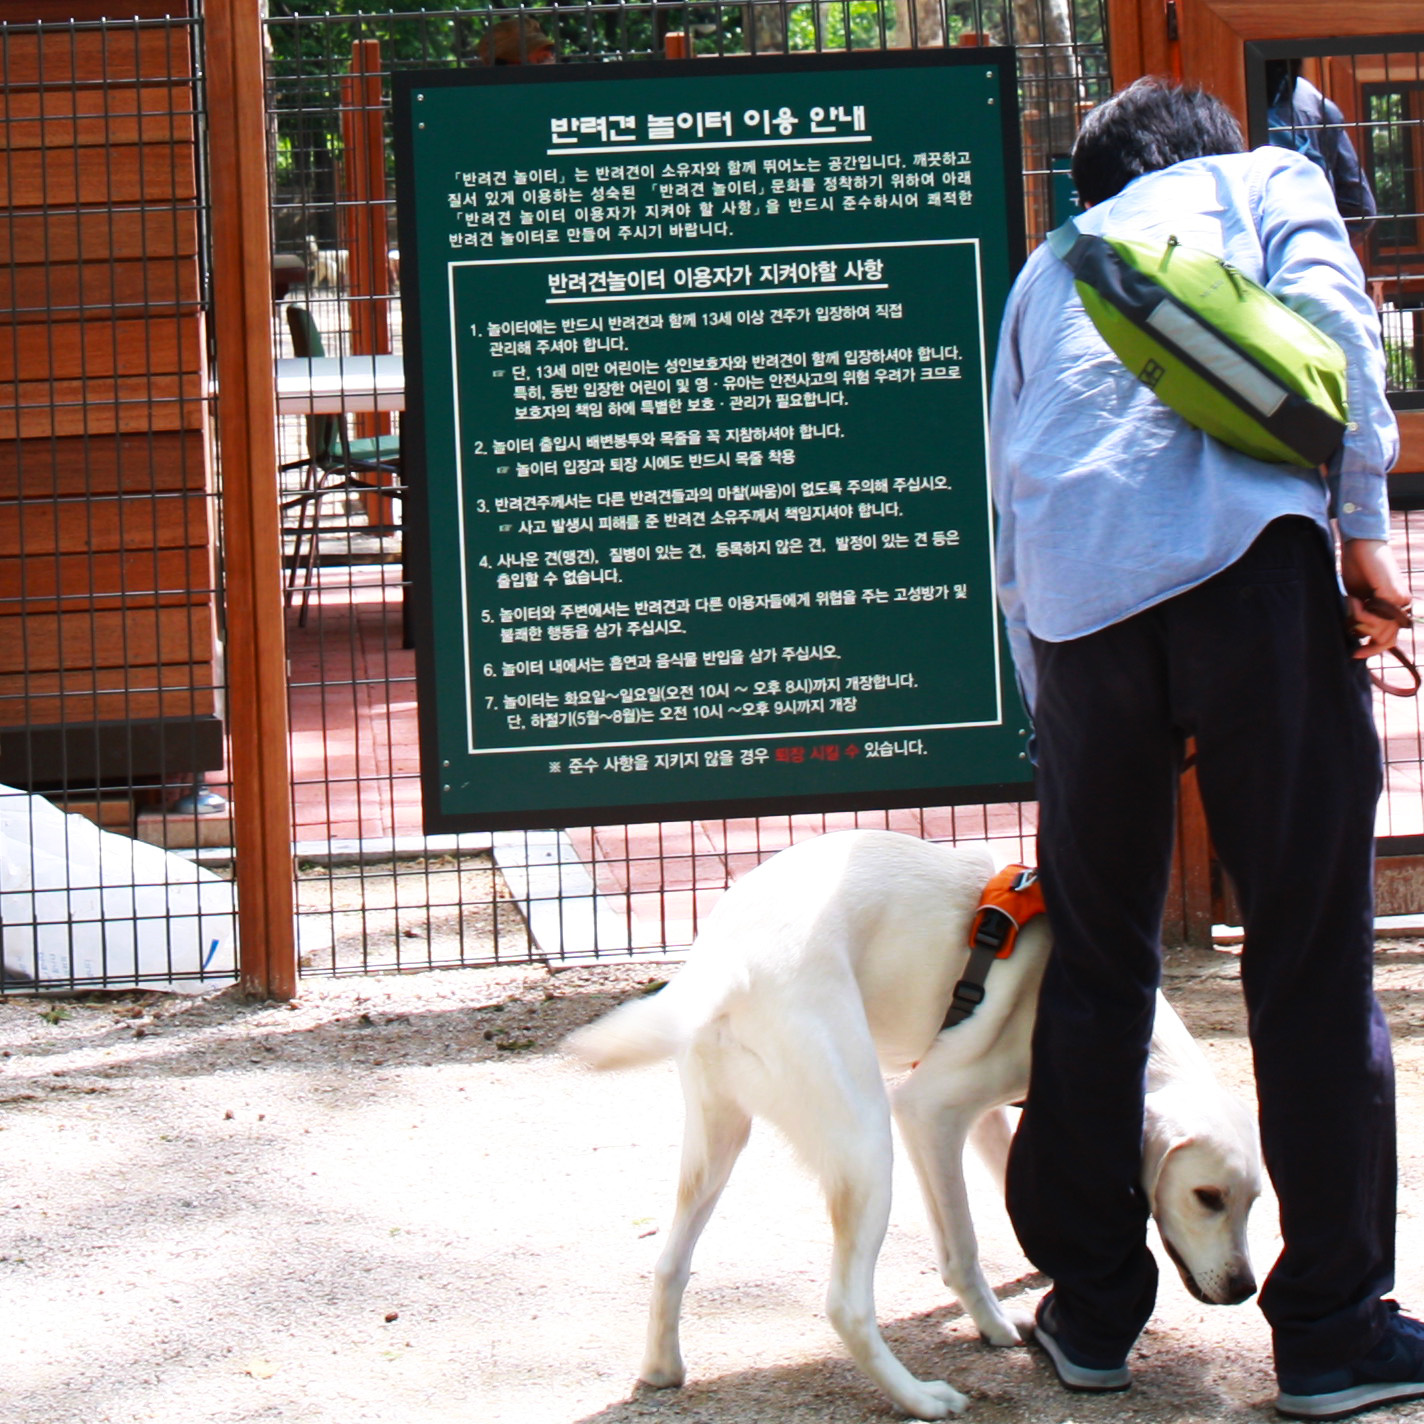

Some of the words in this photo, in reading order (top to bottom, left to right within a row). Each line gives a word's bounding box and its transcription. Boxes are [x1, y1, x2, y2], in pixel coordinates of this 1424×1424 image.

[550, 115, 637, 144] 반려견
[647, 111, 733, 140] 놀이터
[743, 107, 799, 136] 이용
[809, 105, 866, 134] 안내
[595, 163, 655, 182] 반려견이
[661, 161, 721, 178] 소유자와
[727, 159, 757, 176] 함께
[763, 157, 822, 174] 뛰어노는
[828, 153, 906, 172] 공간입니다.
[913, 151, 971, 167] 깨끗하고
[447, 191, 477, 209] 질서
[484, 190, 515, 207] 있게
[522, 187, 584, 205] 이용하는
[591, 185, 636, 202] 성숙된
[823, 174, 883, 192] 정착하기
[891, 172, 935, 189] 위하여
[942, 170, 972, 186] 아래
[519, 208, 566, 225] 놀이터
[574, 205, 637, 223] 이용자가
[645, 202, 691, 219] 지켜야
[788, 196, 834, 213] 반드시
[842, 193, 918, 211] 준수하시어
[927, 190, 973, 207] 쾌적한
[449, 231, 494, 249] 반려견
[500, 228, 560, 246] 놀이터로
[566, 226, 611, 243] 만들어
[618, 224, 662, 241] 주시기
[669, 221, 733, 238] 바랍니다.
[548, 268, 666, 295] 반려견놀이터
[674, 264, 753, 289] 이용자가
[759, 260, 838, 285] 지켜야할
[844, 258, 884, 281] 사항
[486, 319, 557, 338] 놀이터에는
[561, 316, 603, 334] 반드시
[608, 314, 664, 332] 반려견과
[668, 312, 697, 329] 함께
[702, 311, 732, 326] 13세
[736, 309, 765, 326] 이상
[770, 307, 811, 324] 견주가
[815, 304, 870, 322] 입장하여
[875, 303, 903, 319] 직접
[489, 340, 532, 357] 관리해
[536, 337, 579, 355] 주셔야
[582, 336, 629, 353] 합니다.
[536, 363, 567, 379] 13세
[571, 362, 600, 378] 미만
[604, 359, 660, 377] 어린이는
[664, 355, 748, 374] 성인보호자와
[751, 352, 807, 370] 반려견이
[811, 350, 840, 367] 함께
[844, 347, 913, 366] 입장하셔야
[917, 345, 963, 362] 합니다.
[513, 385, 546, 401] 특히,
[550, 383, 579, 400] 동반
[583, 381, 626, 398] 입장한
[629, 378, 671, 395] 어린이
[722, 375, 765, 391] 유아는
[769, 370, 838, 389] 안전사고의
[842, 369, 870, 385] 위험
[874, 367, 916, 384] 우려가
[920, 365, 962, 381] 크므로
[514, 404, 571, 420] 보호자의
[575, 402, 603, 418] 책임
[608, 400, 636, 417] 하에
[640, 398, 683, 415] 특별한
[686, 397, 716, 412] 보호
[729, 394, 772, 412] 관리가
[775, 390, 849, 409] 필요합니다.
[492, 438, 534, 455] 놀이터
[539, 435, 581, 453] 출입시
[586, 431, 656, 450] 배변봉투와
[659, 429, 702, 447] 목줄을
[725, 425, 795, 443] 지참하셔야
[799, 423, 845, 440] 합니다.
[515, 460, 558, 478] 놀이터
[562, 458, 606, 476] 입장과
[609, 456, 638, 473] 퇴장
[642, 455, 685, 471] 시에도
[688, 451, 731, 469] 반드시
[735, 450, 764, 467] 목줄
[768, 448, 796, 465] 착용
[494, 493, 593, 513] 반려견주께서는
[597, 491, 626, 507] 다른
[629, 486, 713, 506] 반려견들과의
[717, 482, 796, 502] 마찰(싸움)이
[800, 480, 843, 498] 없도록
[846, 478, 889, 495] 주의해
[892, 475, 952, 493] 주십시오.
[518, 520, 548, 535] 사고
[551, 516, 594, 534] 발생시
[598, 514, 641, 531] 피해를
[663, 511, 706, 528] 반려견
[710, 507, 780, 525] 소유주께서
[784, 503, 854, 522] 책임지셔야
[857, 501, 903, 519] 합니다.
[496, 551, 540, 569] 사나운
[609, 545, 651, 563] 질병이
[655, 544, 684, 561] 있는
[715, 539, 771, 558] 등록하지
[775, 537, 804, 555] 않은
[835, 534, 877, 552] 발정이
[881, 533, 910, 549] 있는
[496, 571, 540, 590] 출입할
[562, 567, 623, 586] 없습니다.
[499, 605, 556, 623] 놀이터와
[560, 601, 631, 620] 주변에서는
[634, 598, 692, 616] 반려견과
[694, 596, 724, 613] 다른
[727, 591, 811, 611] 이용자들에게
[815, 589, 857, 607] 위협을
[861, 588, 890, 604] 주는
[893, 584, 950, 602] 고성방가
[547, 623, 590, 642] 행동을
[593, 622, 623, 639] 삼가
[626, 619, 687, 637] 주십시오.
[501, 659, 544, 677] 놀이터
[549, 657, 605, 674] 내에서는
[655, 651, 698, 670] 음식물
[702, 648, 745, 667] 반입을
[749, 647, 778, 664] 삼가
[781, 644, 842, 662] 주십시오.
[502, 692, 560, 710] 놀이터는
[699, 682, 730, 699] 10시
[752, 679, 782, 696] 오후
[785, 676, 841, 694] 8시)까지
[845, 672, 918, 692] 개장합니다.
[659, 705, 688, 721] 오전
[692, 703, 724, 719] 10시
[773, 697, 825, 715] 9시까지
[829, 696, 858, 713] 개장
[568, 757, 600, 775] 준수
[603, 753, 650, 773] 사항을
[654, 751, 699, 770] 지키지
[703, 749, 735, 768] 않을
[739, 747, 770, 766] 경우
[864, 738, 928, 758] 있습니다.
